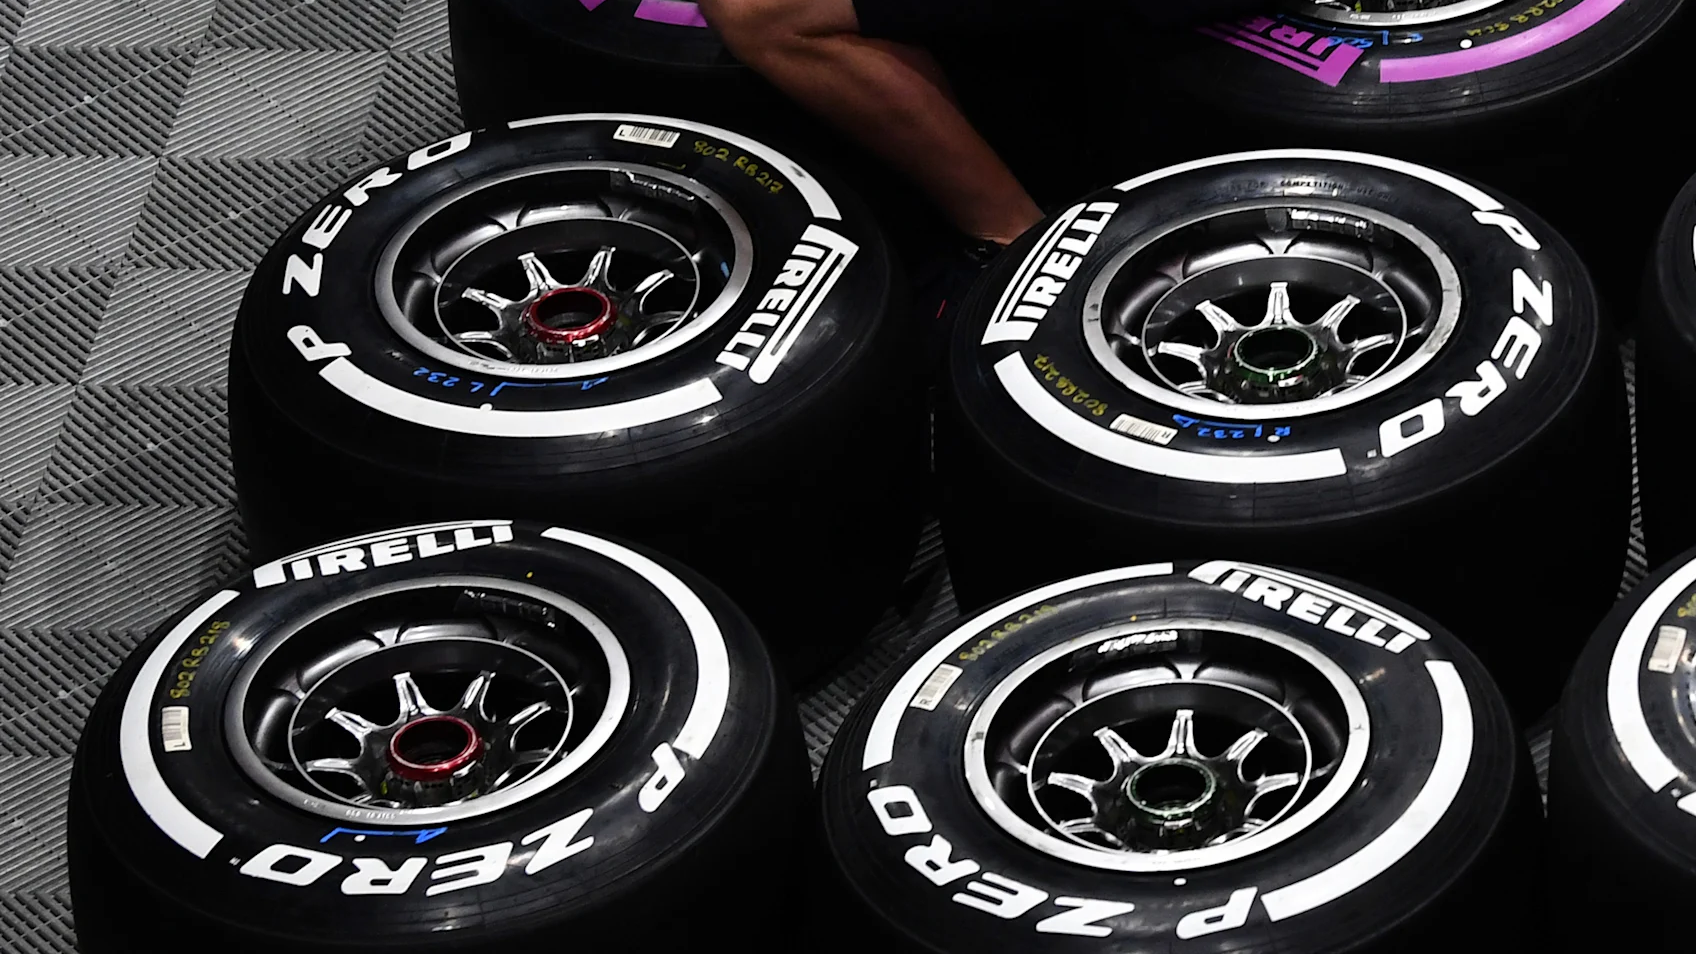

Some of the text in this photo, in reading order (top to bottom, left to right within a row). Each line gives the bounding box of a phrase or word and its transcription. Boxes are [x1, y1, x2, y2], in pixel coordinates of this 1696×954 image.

[282, 131, 472, 362] P ZERO
[715, 224, 860, 384] PIRELLI
[981, 201, 1120, 346] PIRELLI
[1379, 209, 1554, 458] P ZERO
[253, 518, 514, 589] PIRELLI
[1186, 559, 1431, 655] PIRELLI
[239, 742, 686, 898] P ZERO
[866, 783, 1259, 940] P ZERO
